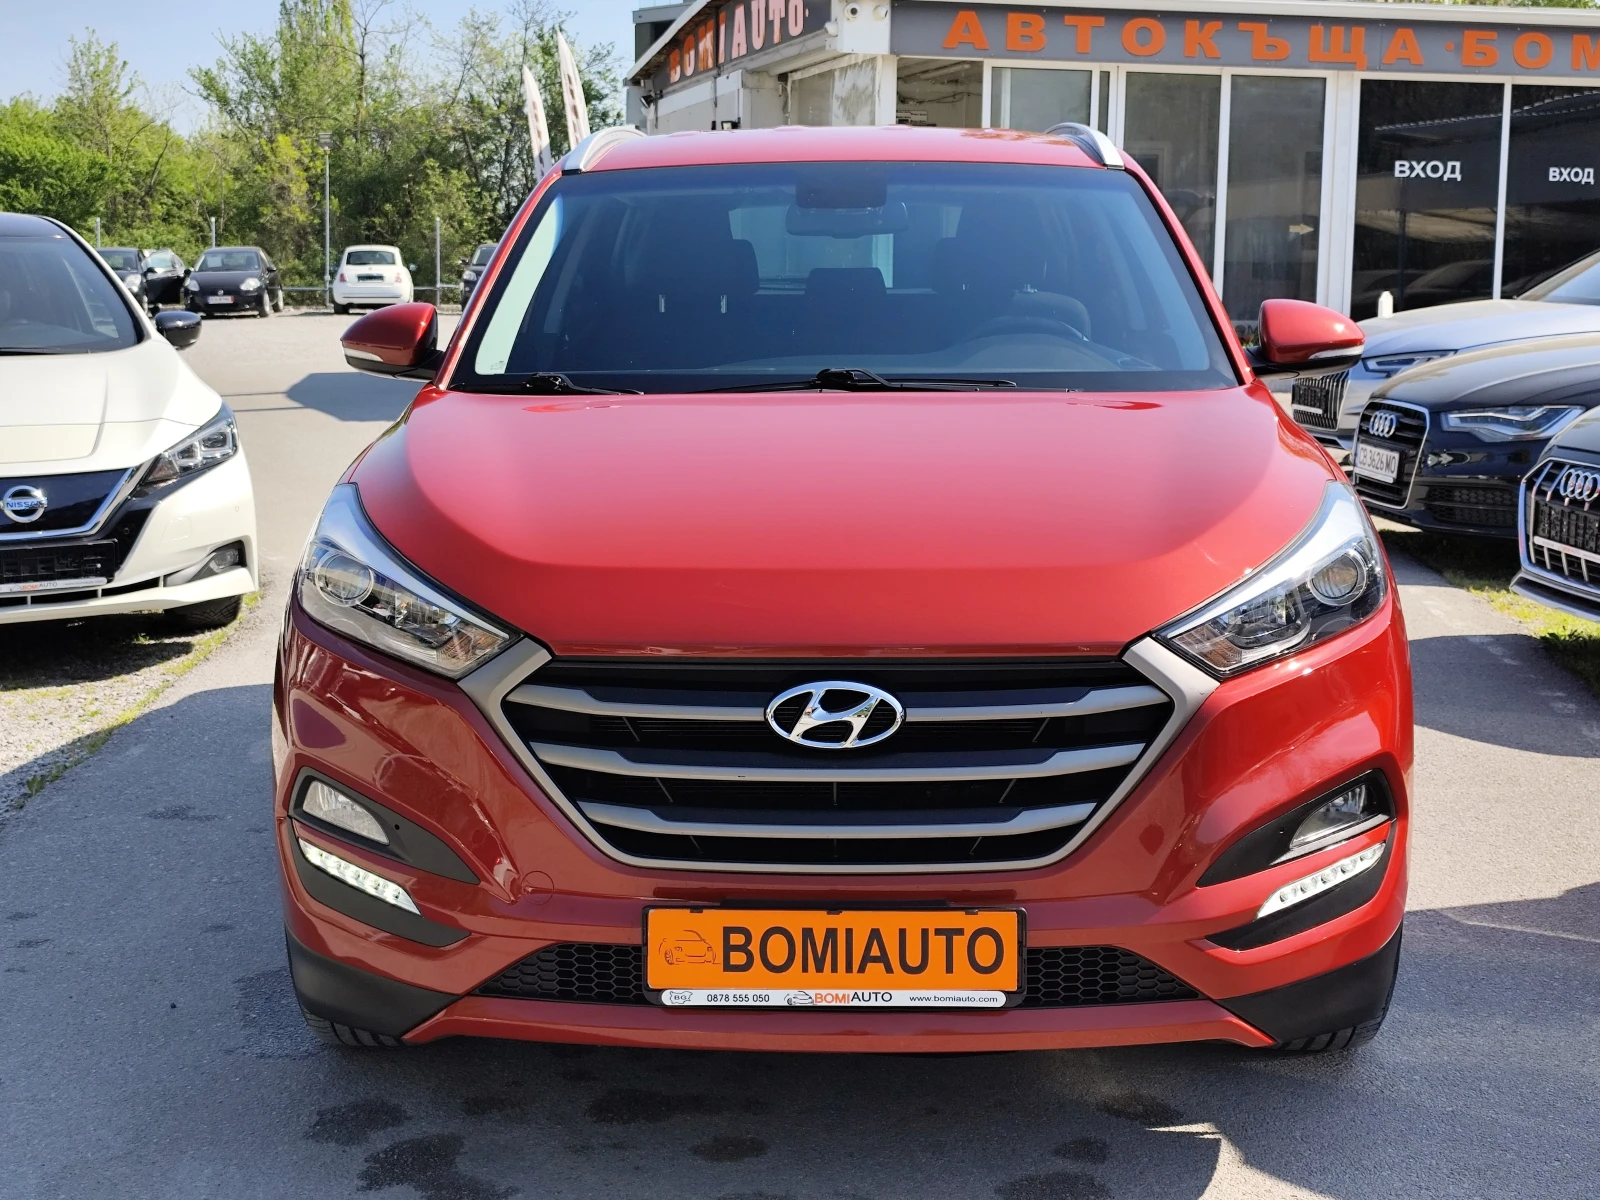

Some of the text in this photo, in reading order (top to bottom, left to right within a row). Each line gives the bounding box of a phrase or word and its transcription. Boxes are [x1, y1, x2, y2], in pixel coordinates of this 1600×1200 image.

[942, 10, 1424, 71] АВТОКЪЩА
[1394, 160, 1462, 181] ВХОД
[1548, 167, 1595, 185] ВХОД
[722, 926, 1005, 975] BOMIAUTO
[706, 993, 730, 1003] 0878
[732, 993, 750, 1003] 555
[752, 993, 770, 1003] 050
[909, 995, 998, 1003] www.bomiauto.com
